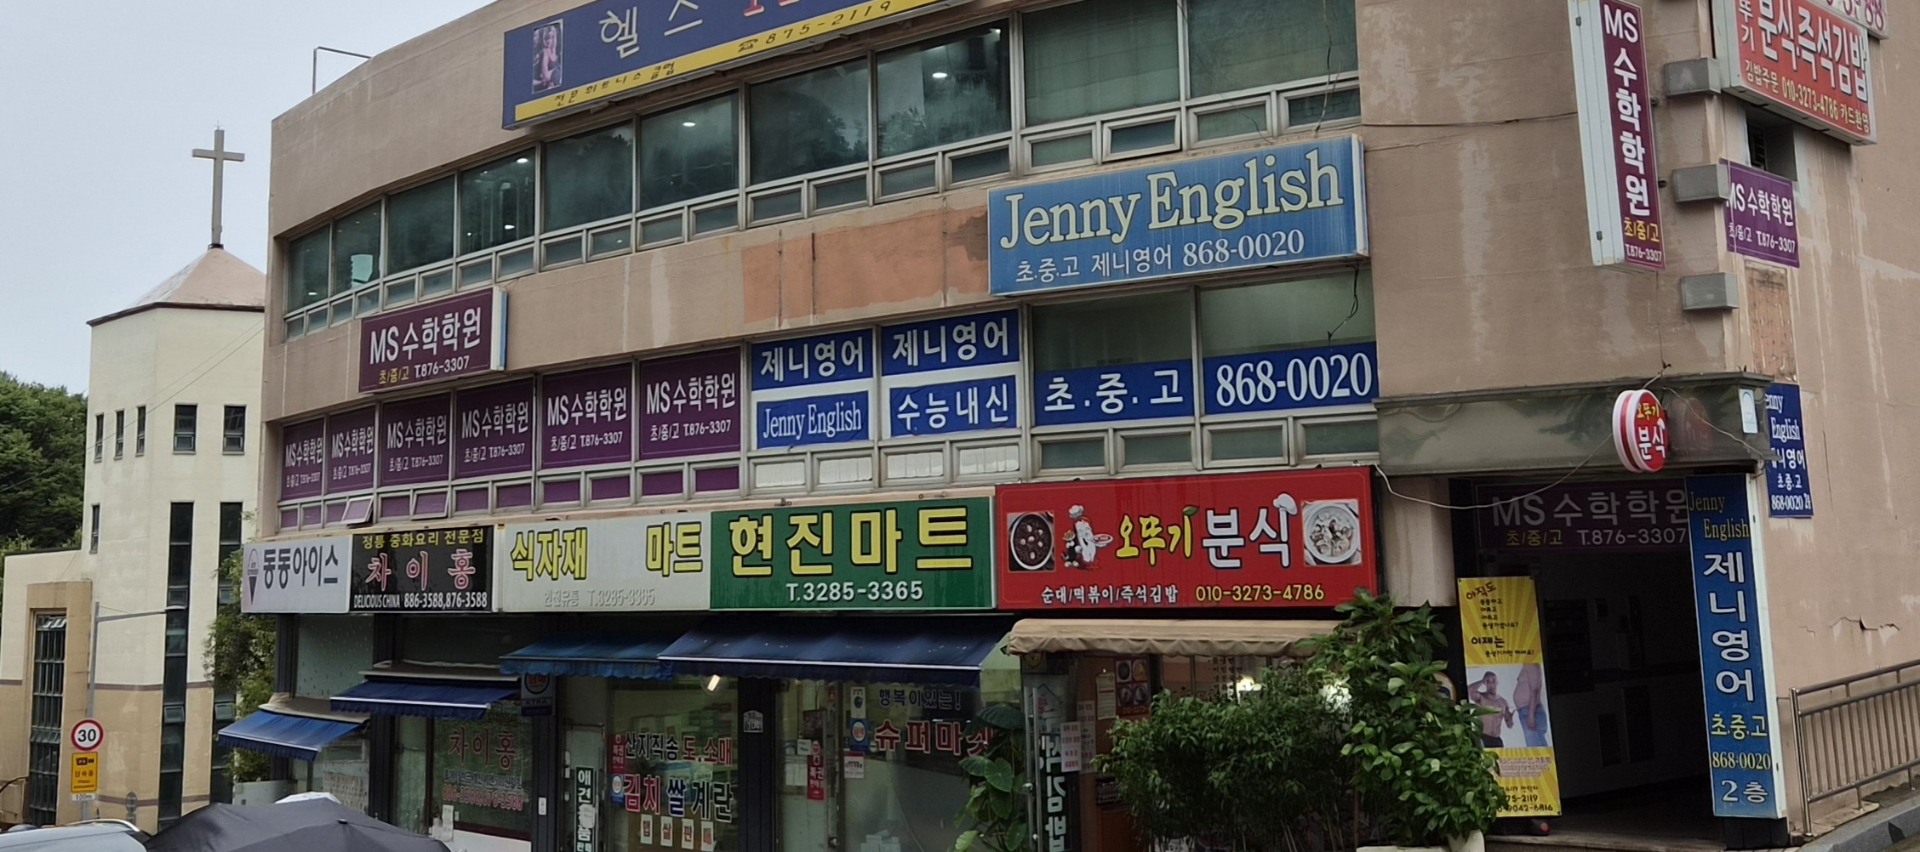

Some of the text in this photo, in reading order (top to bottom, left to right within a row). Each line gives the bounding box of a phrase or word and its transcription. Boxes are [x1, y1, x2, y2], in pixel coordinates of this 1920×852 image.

[765, 1, 892, 44] 875-2119
[1782, 76, 1839, 120] 010-3273-4786
[1000, 149, 1344, 248] Jenny English
[1624, 217, 1660, 242] 초/중/고
[1091, 244, 1172, 277] 제니영어
[1183, 229, 1304, 266] 868-0020
[893, 318, 1008, 366] 제니영어
[379, 355, 470, 384] 초/중/고 T.876-3307
[761, 337, 863, 382] 제니영어
[1216, 352, 1372, 407] 868-0020
[897, 383, 1008, 431] 수능내신
[1765, 394, 1783, 413] enny
[650, 420, 731, 441] 초/중/고 T.876-3307
[763, 401, 862, 440] Jenny English
[1770, 417, 1800, 443] English
[464, 443, 525, 462] 초/중/고 T.876-3307
[550, 431, 623, 451] 초/중/고 T.876-3307
[1638, 426, 1666, 460] 분식
[1689, 491, 1725, 513] Jenny
[362, 528, 484, 550] 정통 중화요리 전문점
[730, 507, 972, 576] 현진마트
[1116, 507, 1291, 568] 오뚜기 분식
[1506, 528, 1686, 546] 초/중/고 T.876-3307
[1704, 518, 1750, 541] English
[511, 521, 703, 581] 식자재 마트
[263, 545, 338, 589] 동동아이스
[786, 581, 923, 601] T.3285-3365
[1196, 584, 1324, 602] 010-3273-4786
[1466, 581, 1496, 599] 아직도
[1703, 552, 1754, 701] 제니영어
[78, 729, 96, 742] 30
[625, 731, 679, 761] 산지직송
[1712, 752, 1771, 769] 868-0020
[624, 774, 733, 822] 김치 쌀 계란
[1506, 795, 1538, 803] 75-2119
